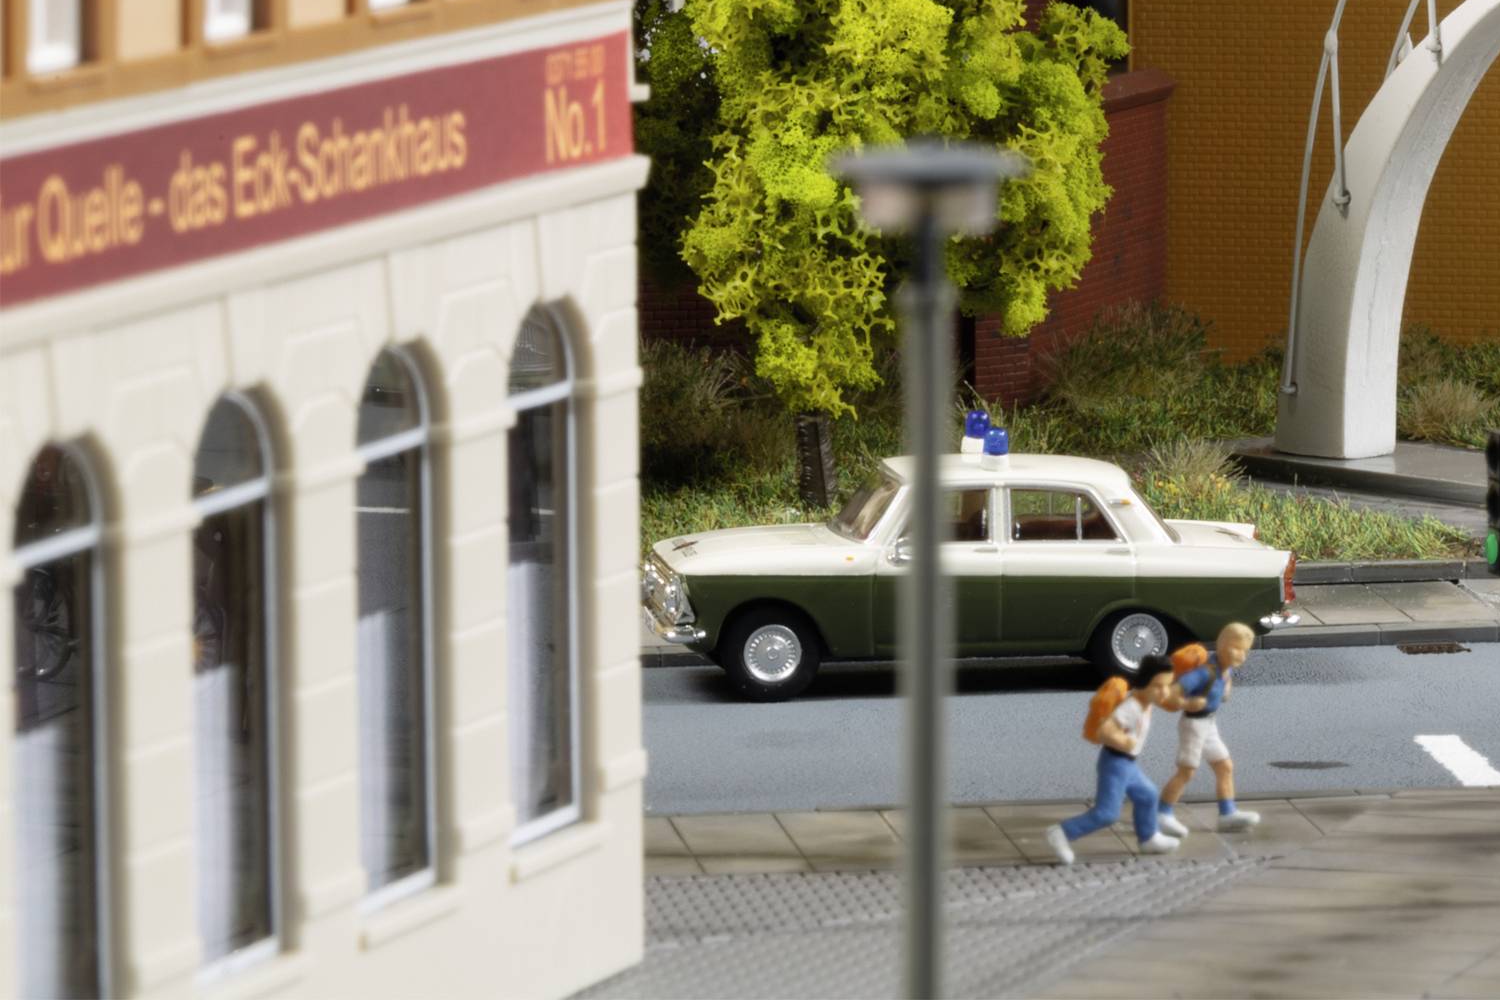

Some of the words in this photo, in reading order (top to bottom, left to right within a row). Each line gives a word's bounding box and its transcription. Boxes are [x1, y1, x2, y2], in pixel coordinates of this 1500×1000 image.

[37, 162, 144, 264] Quelle
[168, 147, 229, 234] das
[232, 103, 468, 220] Eck-Schankhaus
